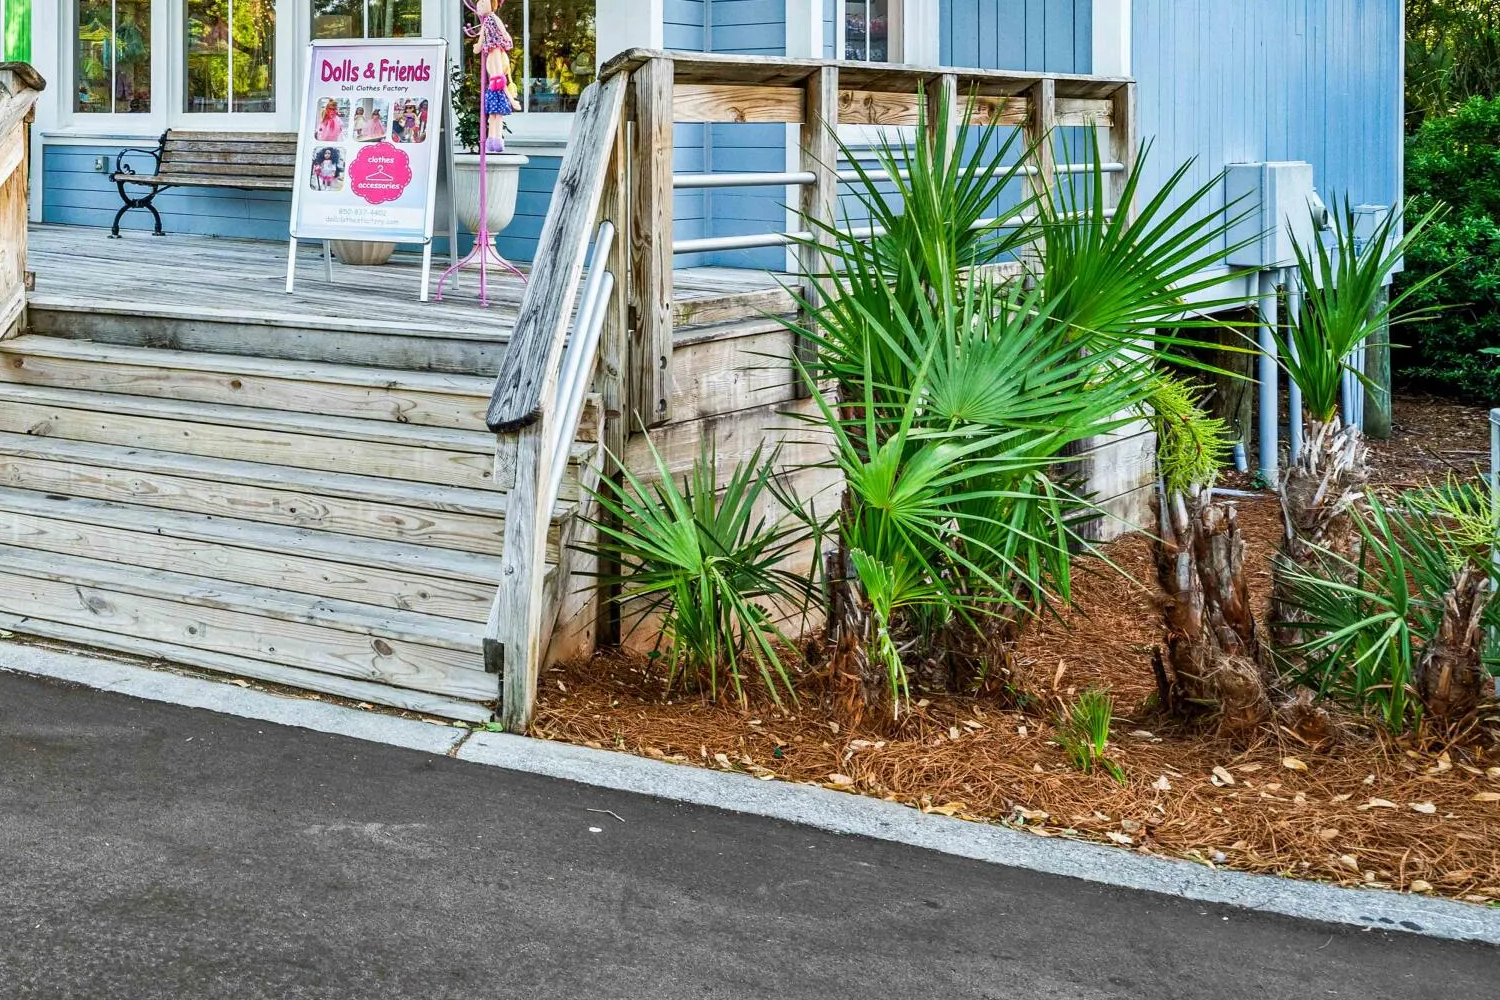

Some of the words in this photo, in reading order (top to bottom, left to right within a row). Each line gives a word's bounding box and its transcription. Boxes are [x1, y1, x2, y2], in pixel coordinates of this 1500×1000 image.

[321, 59, 360, 82] Dolls
[363, 62, 376, 79] &
[379, 58, 431, 82] Friends
[367, 156, 395, 164] clothes
